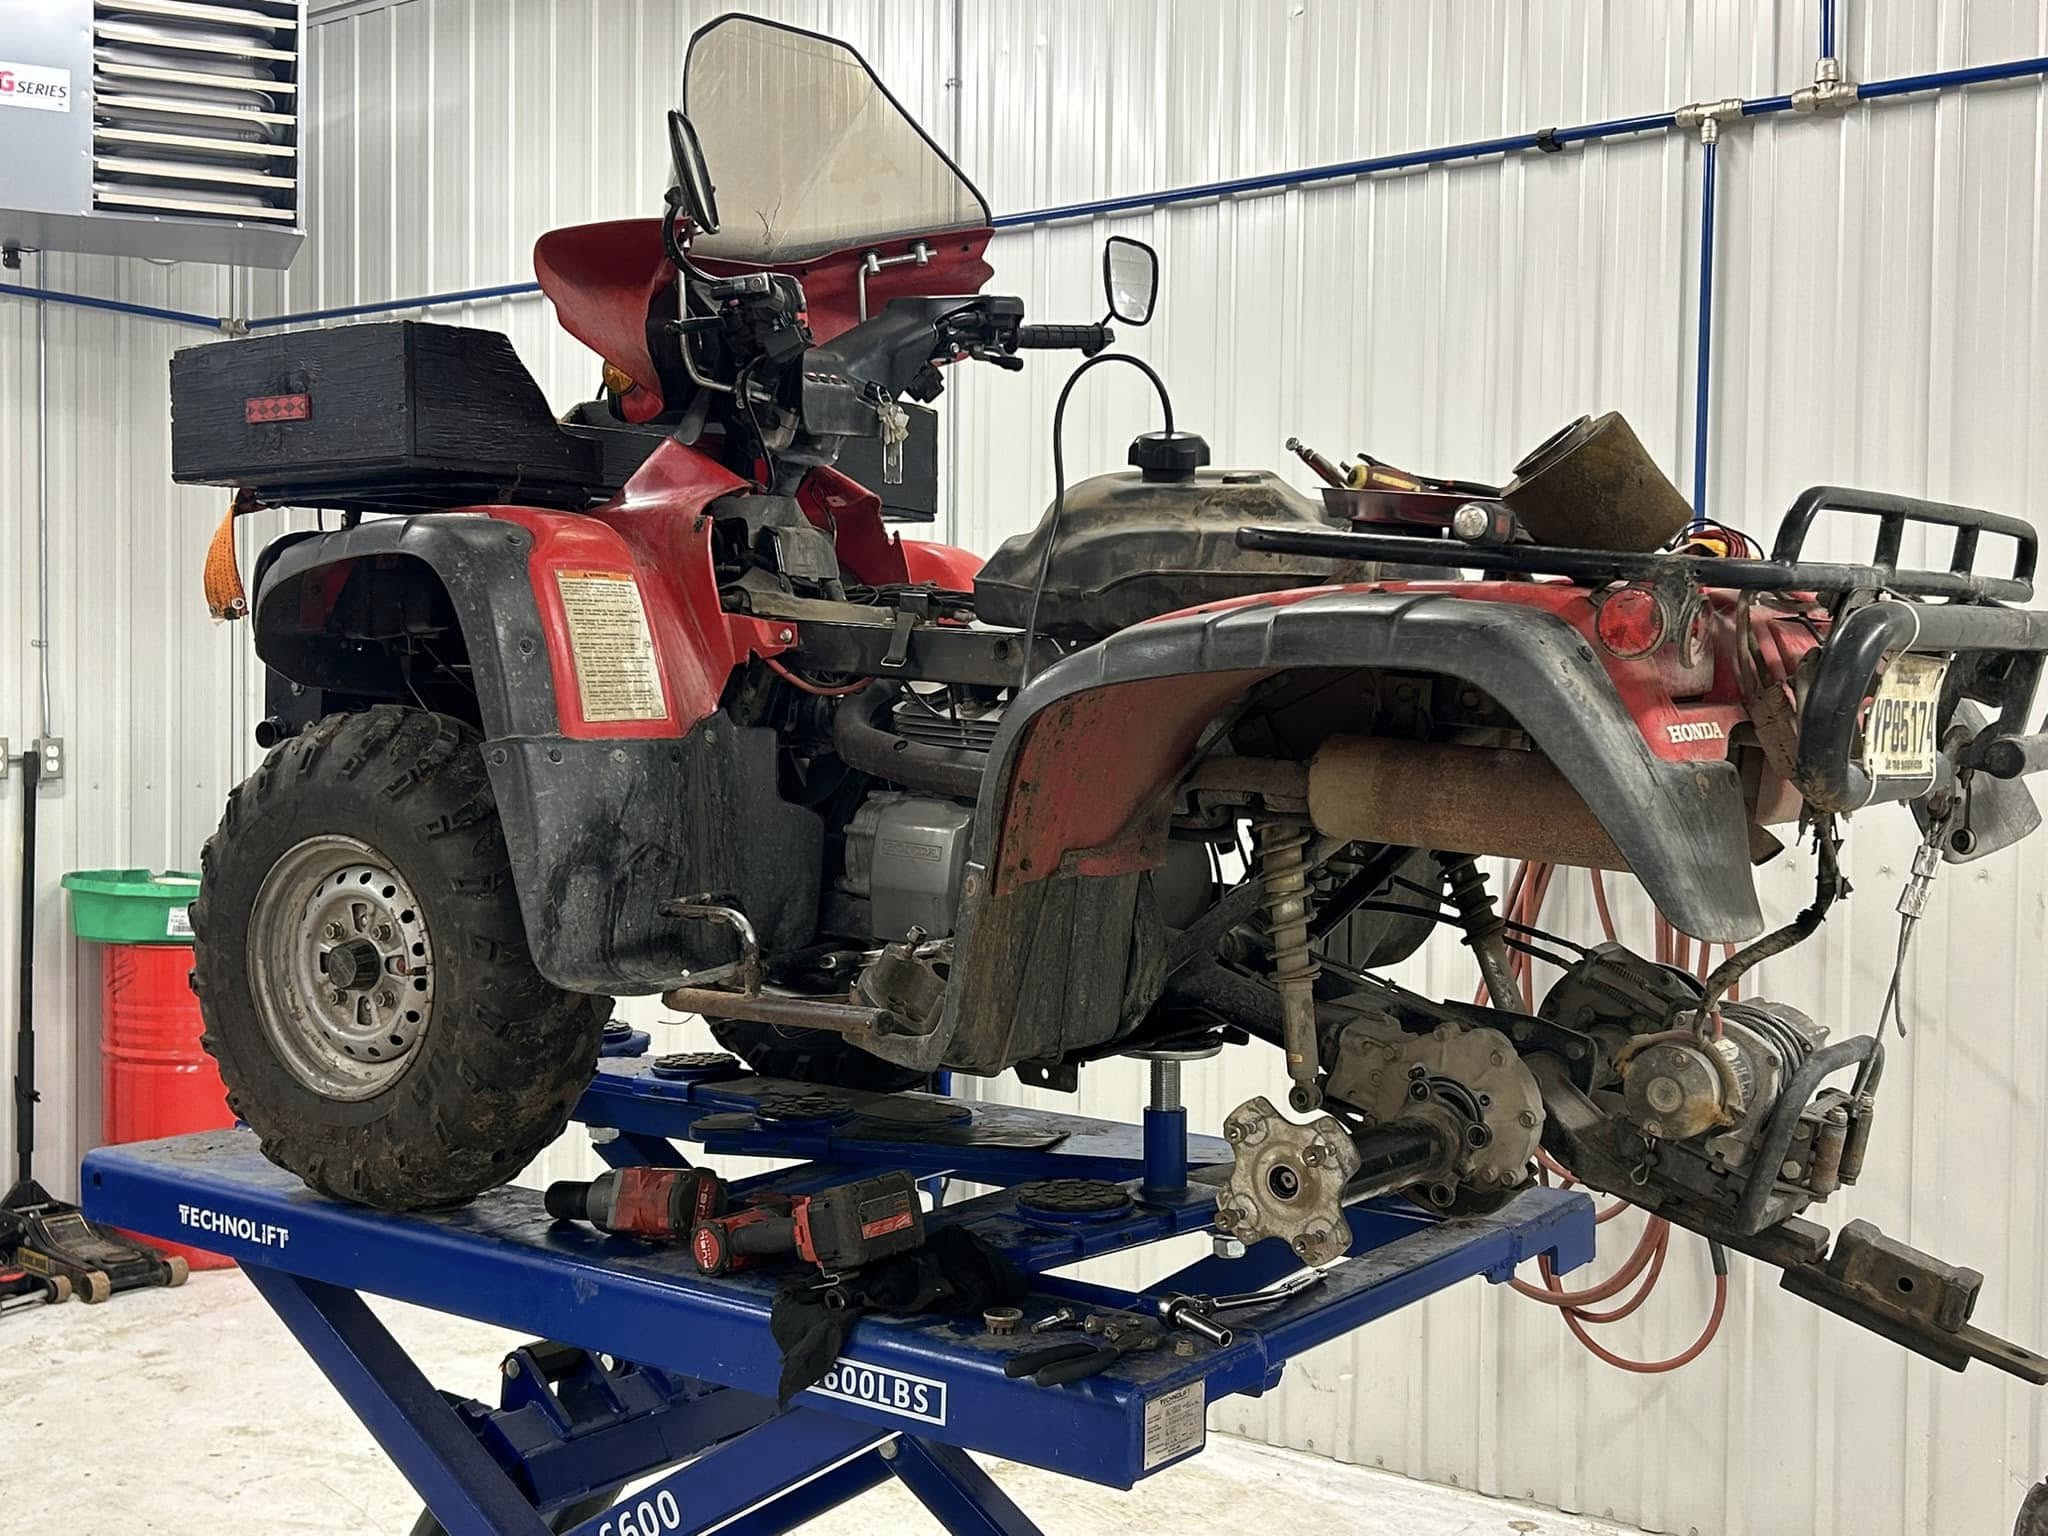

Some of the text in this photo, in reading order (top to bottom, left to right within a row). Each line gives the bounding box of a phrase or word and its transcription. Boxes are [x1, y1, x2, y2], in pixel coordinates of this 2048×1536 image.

[16, 80, 68, 99] SERIES
[1666, 721, 1725, 744] HONDA
[178, 1203, 288, 1249] TECHNOLIFT
[814, 1362, 929, 1414] 600LBS
